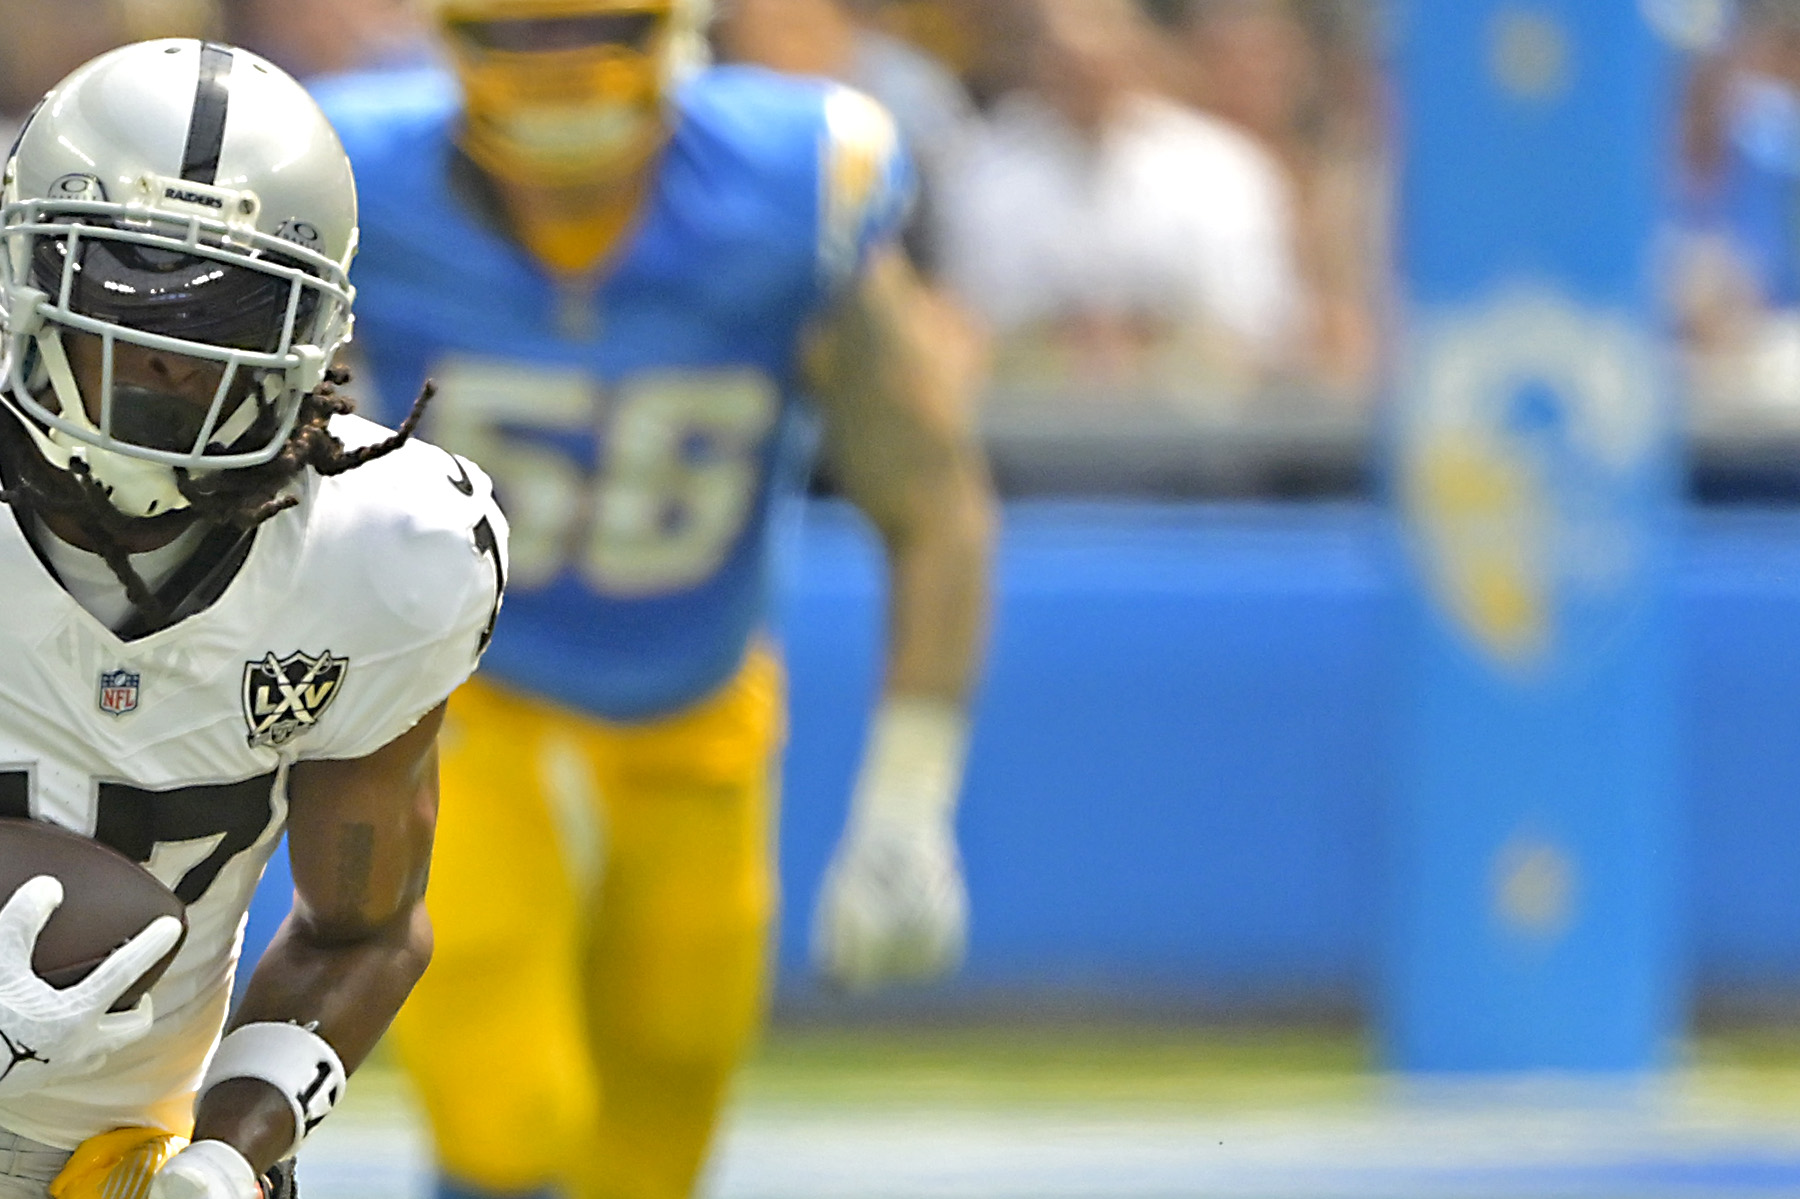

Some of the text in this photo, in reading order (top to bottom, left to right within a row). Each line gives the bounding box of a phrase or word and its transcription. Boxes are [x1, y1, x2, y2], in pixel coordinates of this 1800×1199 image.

[164, 188, 223, 209] RAIDERS
[102, 688, 136, 710] NFL
[254, 680, 336, 722] LXV
